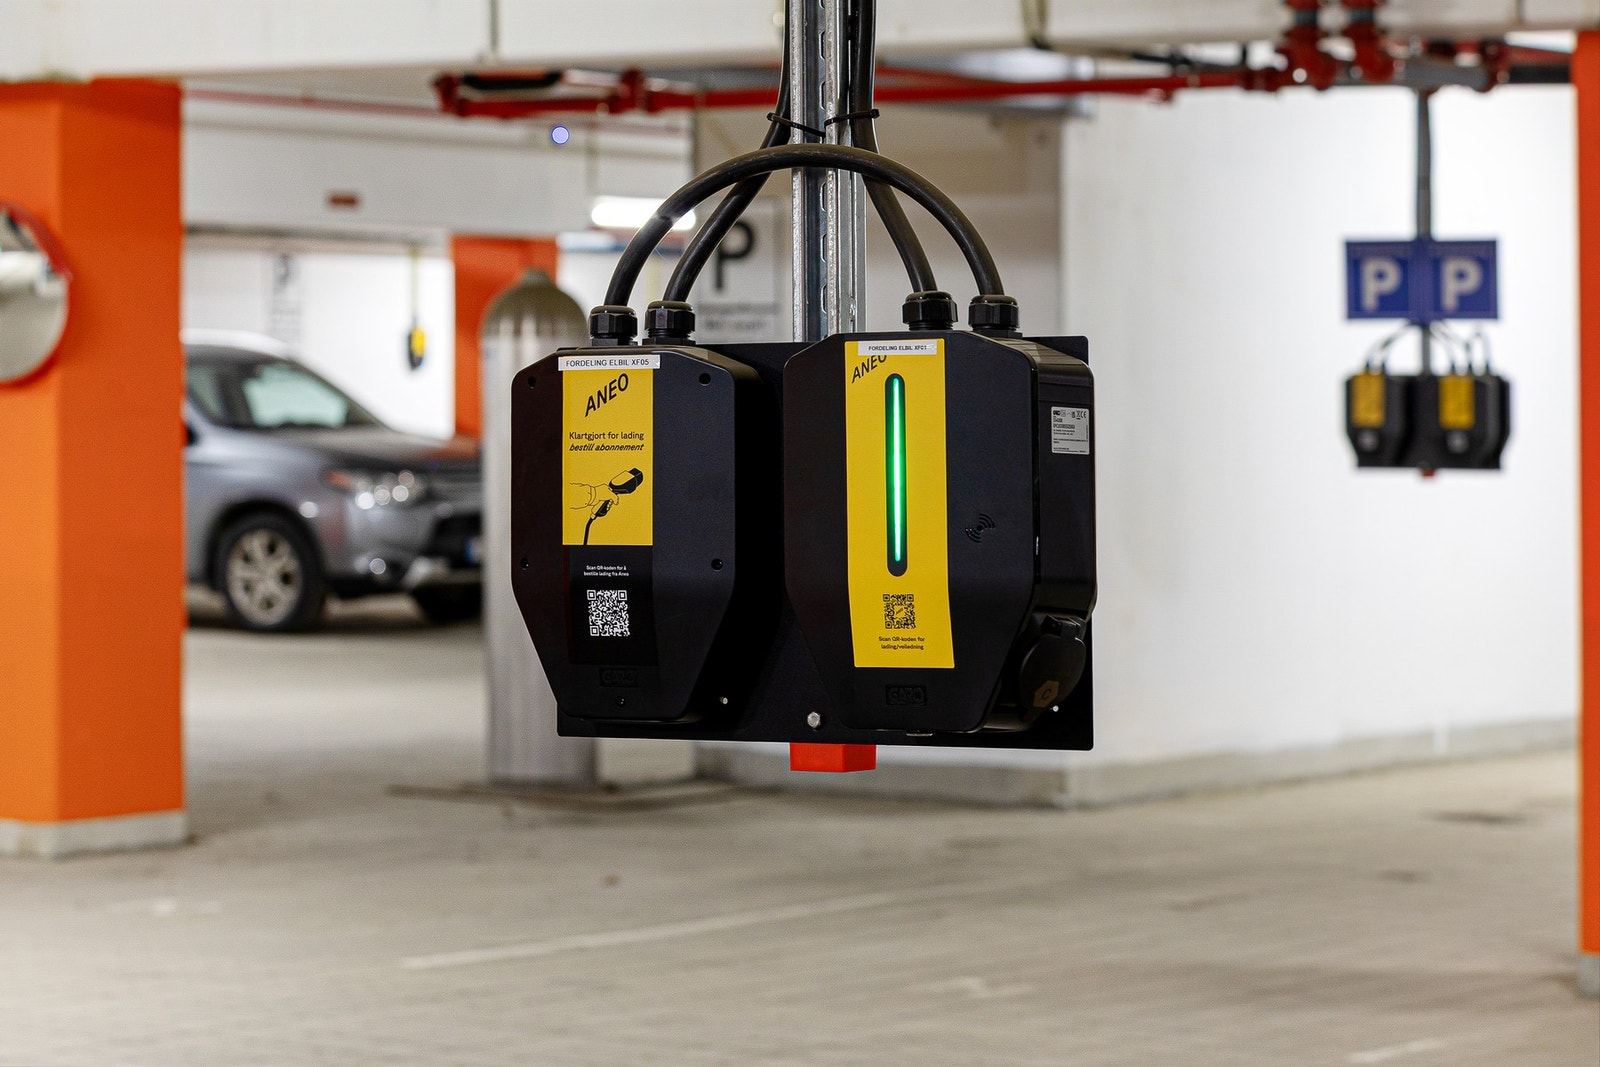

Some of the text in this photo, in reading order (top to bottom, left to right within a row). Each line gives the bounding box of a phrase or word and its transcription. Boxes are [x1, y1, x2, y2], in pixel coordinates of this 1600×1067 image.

[1361, 256, 1401, 312] P
[1442, 256, 1483, 312] P
[566, 359, 607, 367] FORDELING
[584, 373, 629, 418] ANEO
[569, 432, 606, 441] Klartgjort
[620, 432, 644, 441] lading
[569, 443, 644, 451] bestill abonnement
